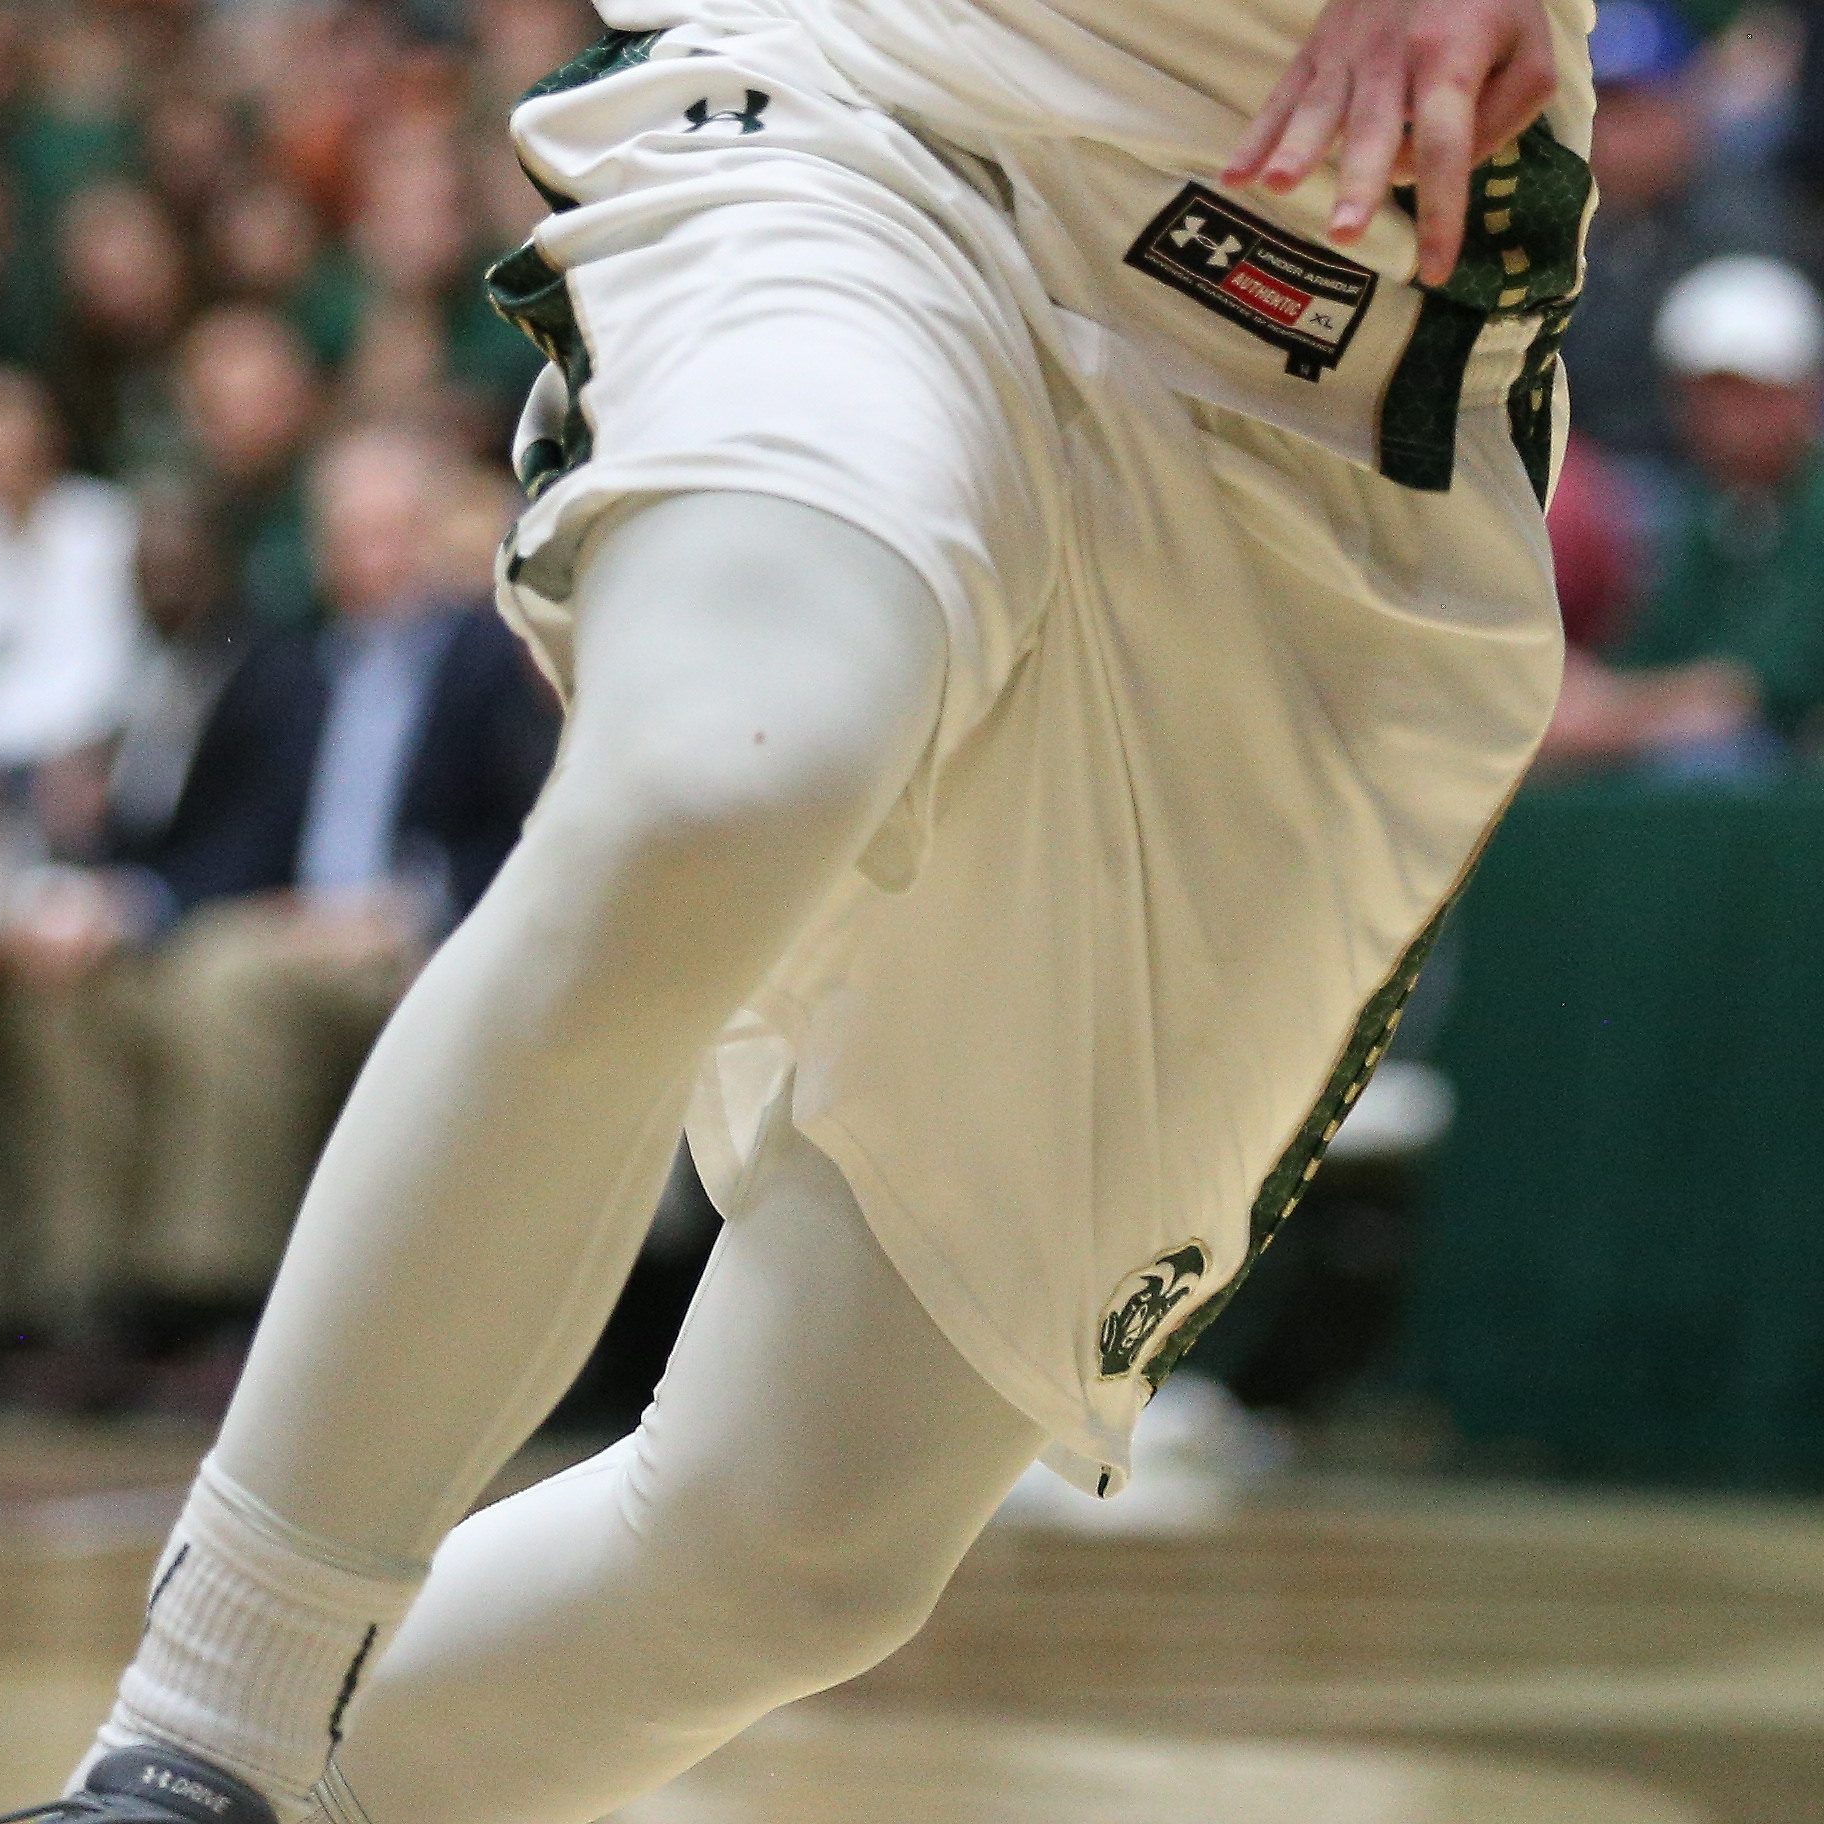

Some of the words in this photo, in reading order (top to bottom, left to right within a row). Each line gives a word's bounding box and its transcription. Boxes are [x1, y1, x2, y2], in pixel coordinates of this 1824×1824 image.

[1256, 248, 1306, 277] UNDER
[1230, 271, 1303, 317] AUTHENTIC
[1309, 312, 1333, 330] XL
